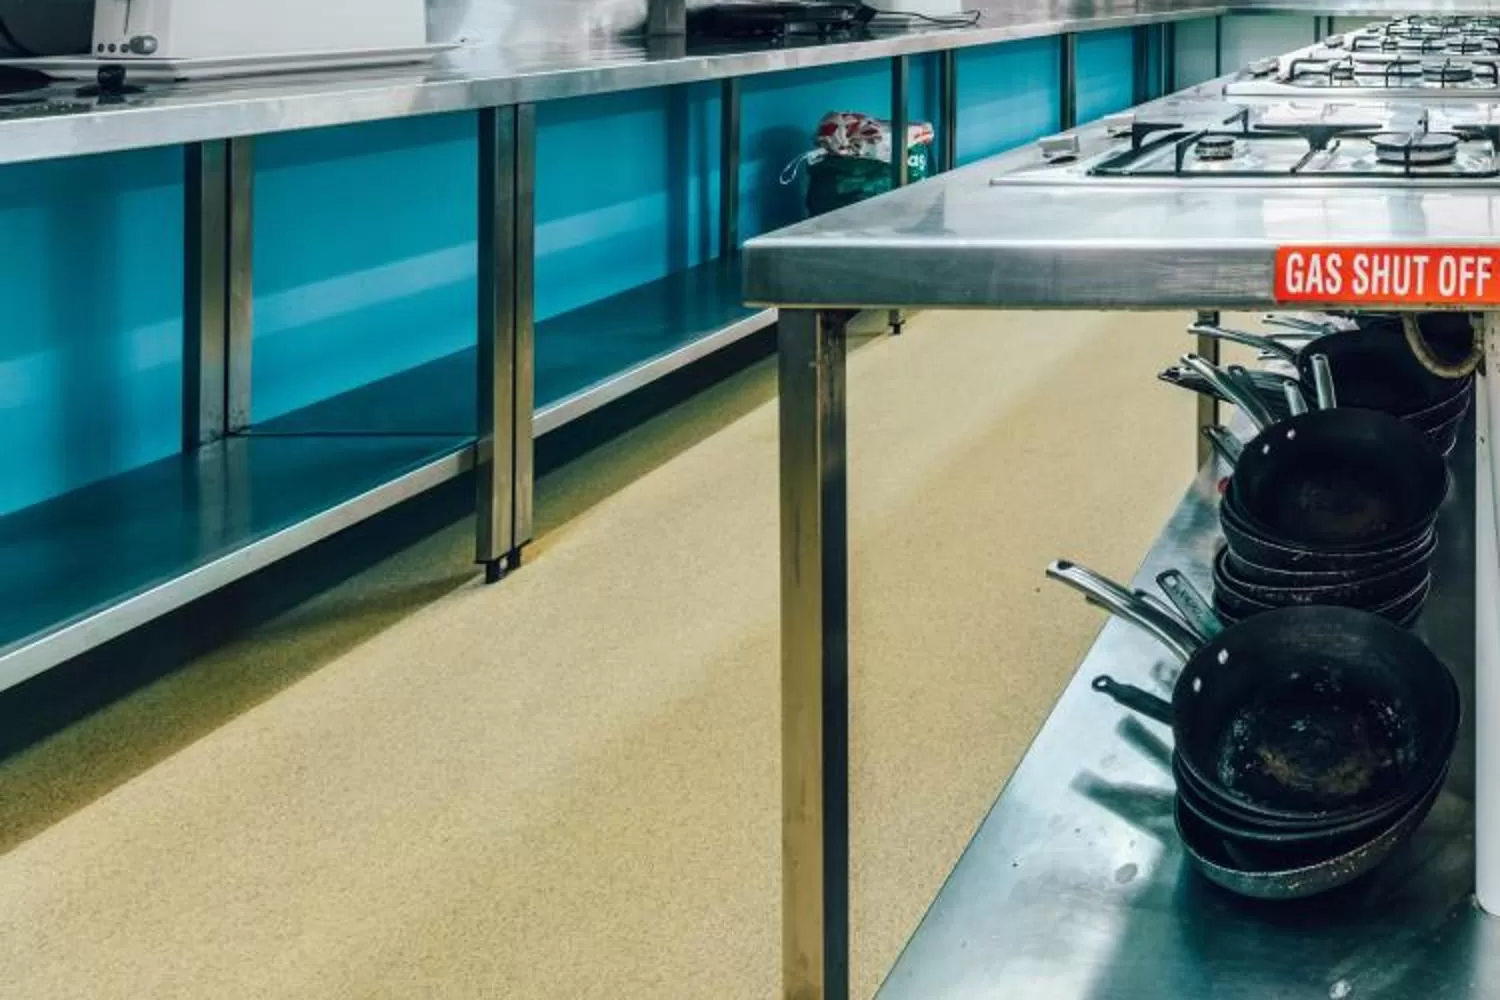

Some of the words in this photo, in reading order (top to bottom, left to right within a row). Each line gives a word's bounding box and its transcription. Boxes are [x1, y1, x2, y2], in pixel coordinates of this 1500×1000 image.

[1285, 252, 1342, 295] GAS
[1351, 253, 1430, 296] SHUT
[1438, 255, 1491, 297] OFF
